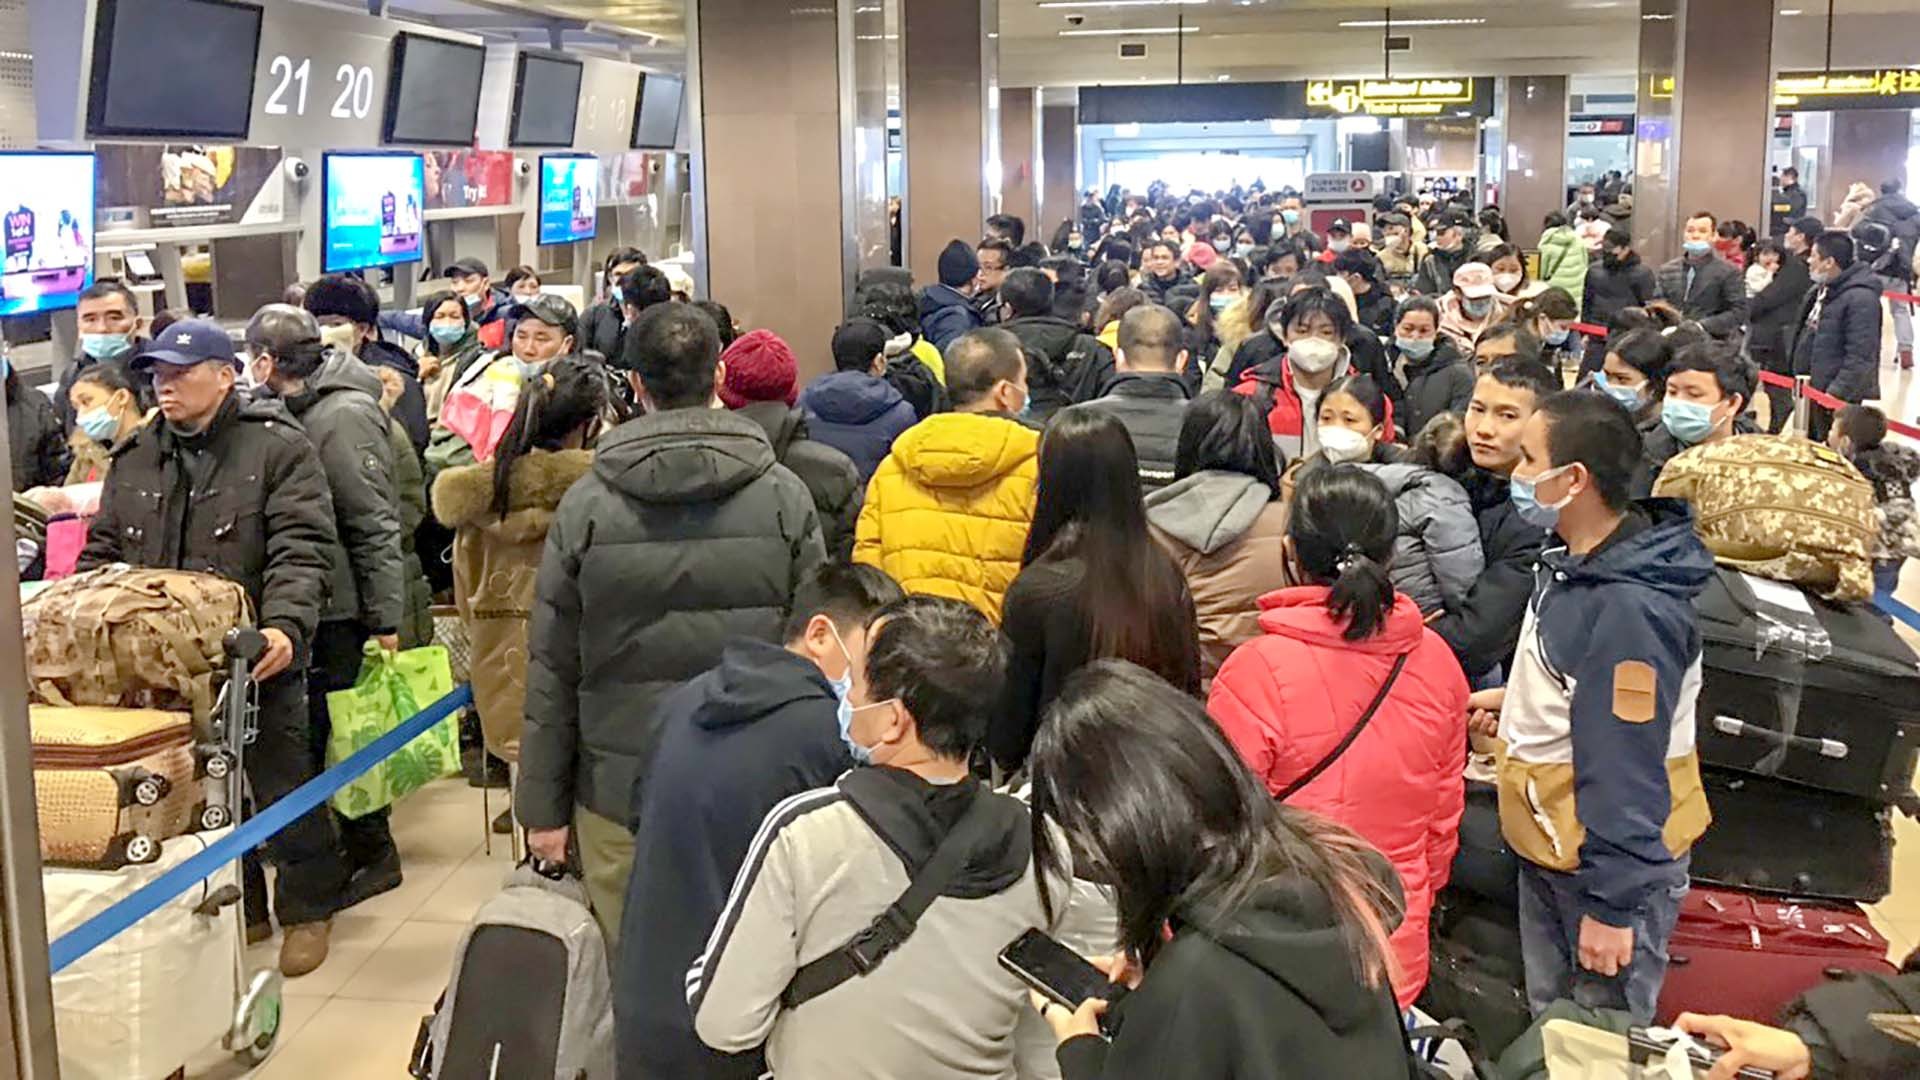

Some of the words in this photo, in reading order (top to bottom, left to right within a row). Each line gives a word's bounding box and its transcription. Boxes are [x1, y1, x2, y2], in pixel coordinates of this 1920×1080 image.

[264, 55, 311, 115] 21
[330, 63, 374, 119] 20
[608, 97, 627, 133] 18
[463, 184, 477, 202] Try
[9, 212, 32, 228] WIN
